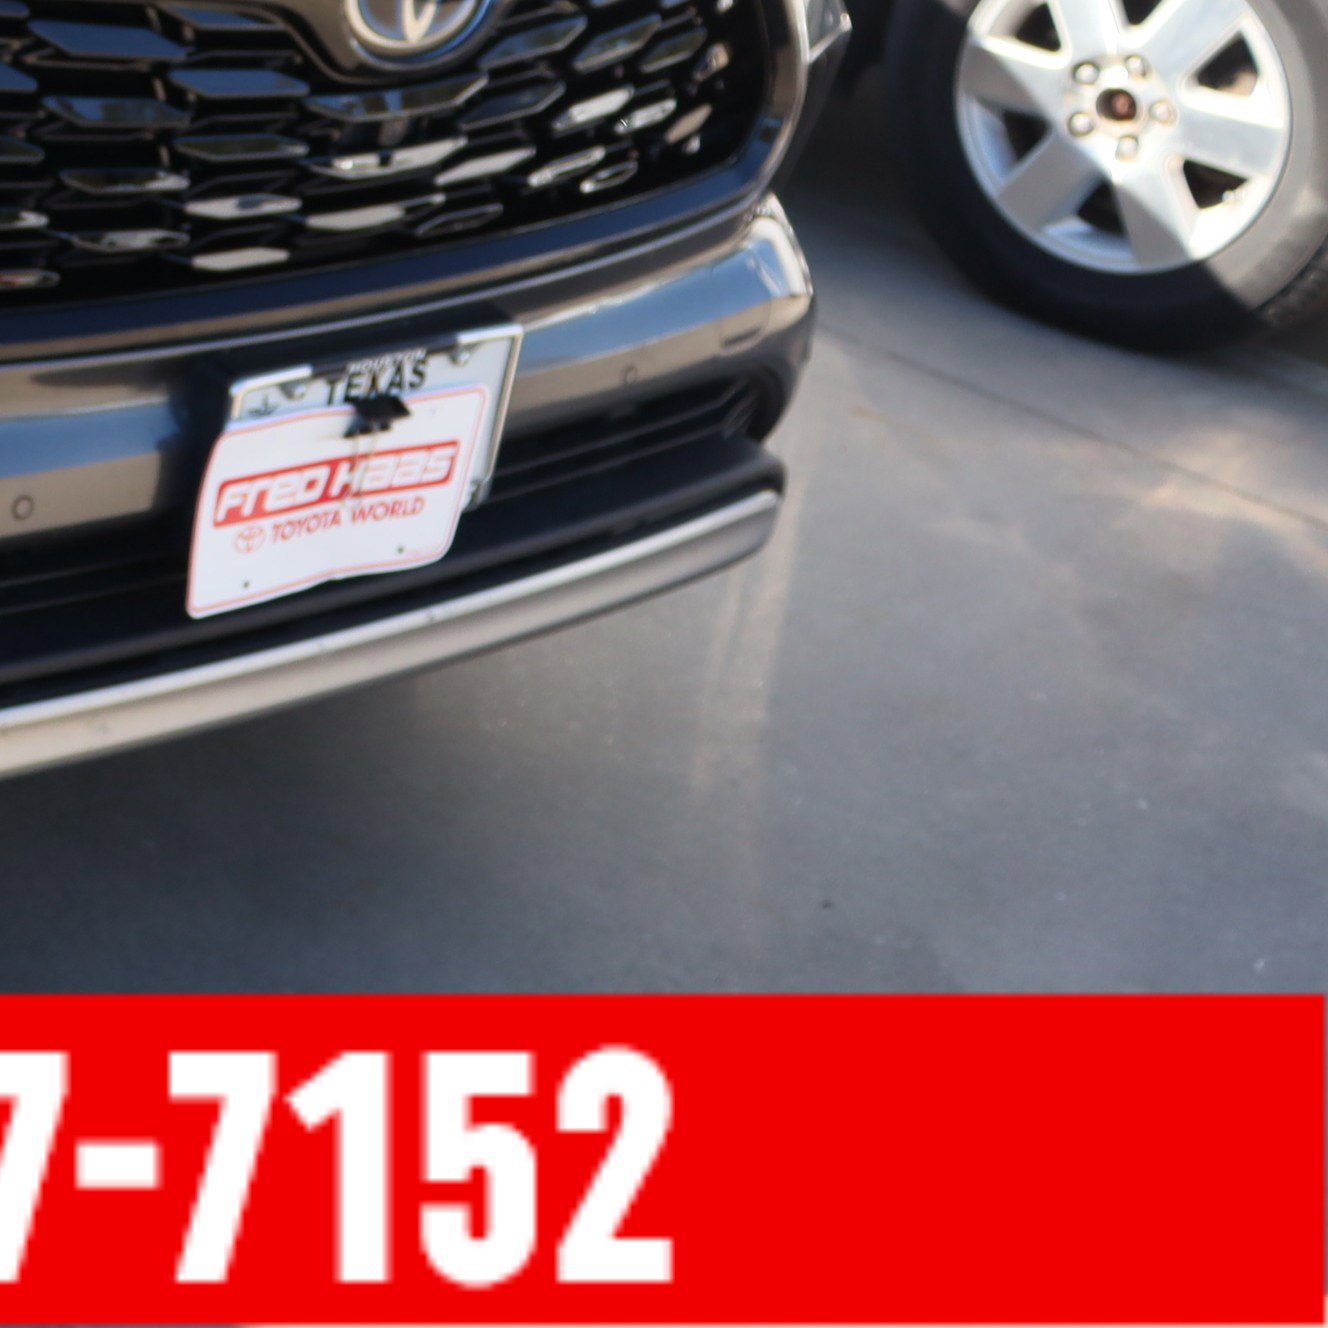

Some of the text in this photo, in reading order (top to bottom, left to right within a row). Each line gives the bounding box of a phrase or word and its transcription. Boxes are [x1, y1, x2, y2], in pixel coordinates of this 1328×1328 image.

[325, 357, 427, 407] TEXAS
[271, 496, 426, 543] TOYOTA WORLD
